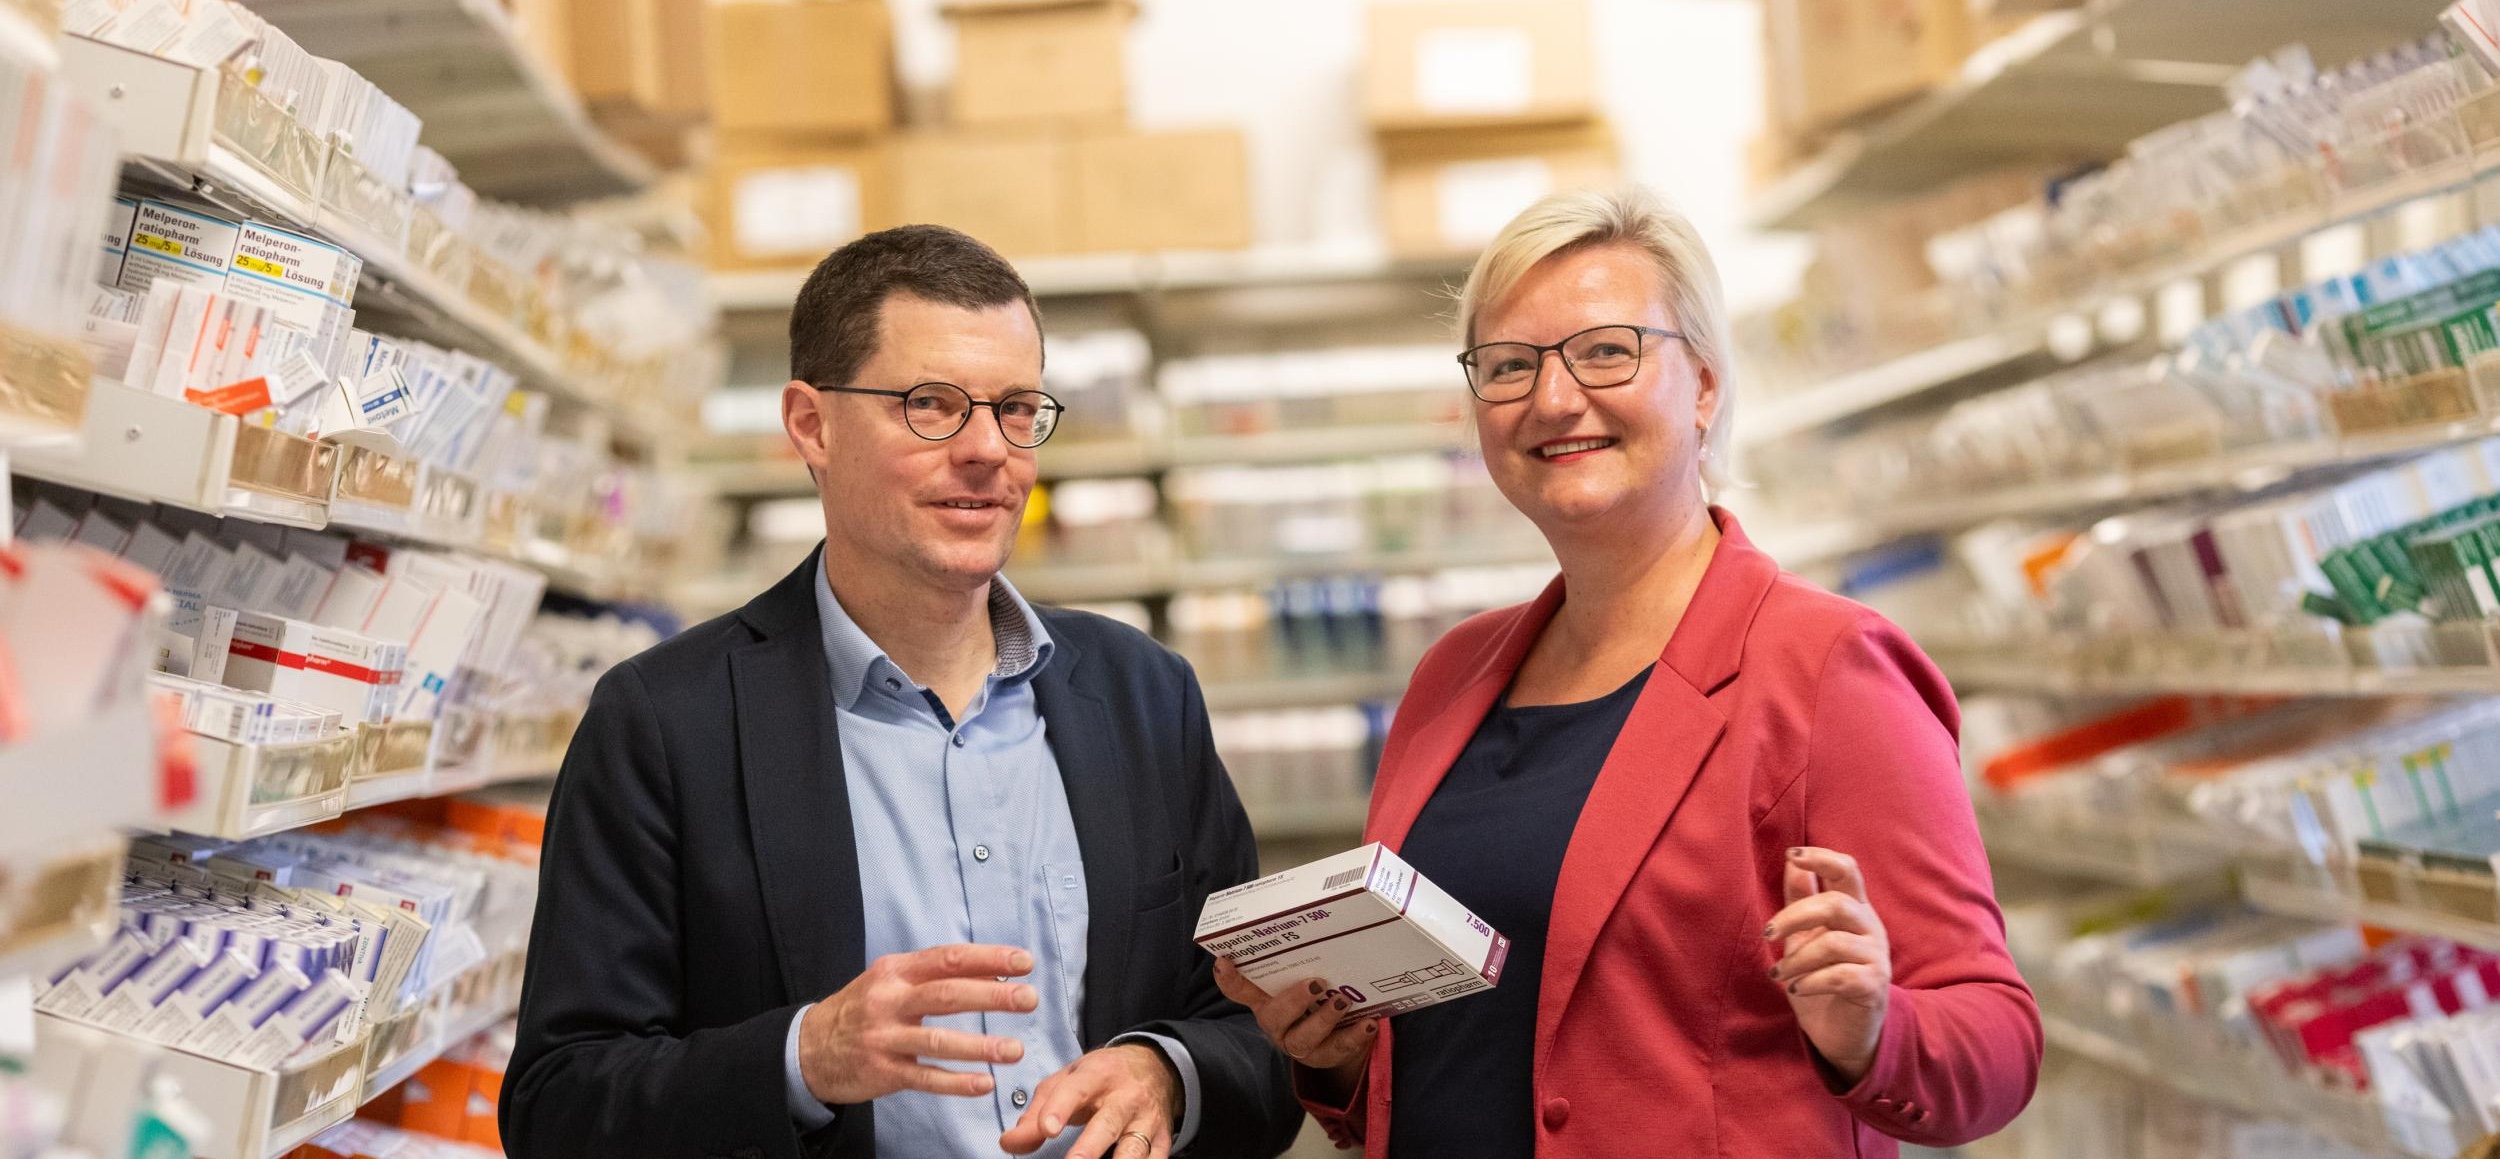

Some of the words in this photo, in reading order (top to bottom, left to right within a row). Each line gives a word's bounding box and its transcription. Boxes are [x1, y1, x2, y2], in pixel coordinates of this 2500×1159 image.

[143, 207, 200, 231] Melperon-
[139, 222, 200, 246] ratiopharm
[244, 229, 302, 253] Melperon-
[134, 233, 149, 246] 25
[184, 246, 223, 267] Lösung
[240, 243, 301, 268] ratiopharm
[235, 255, 250, 267] 25
[285, 269, 325, 290] Lösung
[1465, 913, 1490, 937] 7.500
[1222, 937, 1282, 960] atiopharm
[1282, 931, 1301, 942] FS
[1487, 964, 1499, 977] 10
[1435, 980, 1484, 997] ratiopharm
